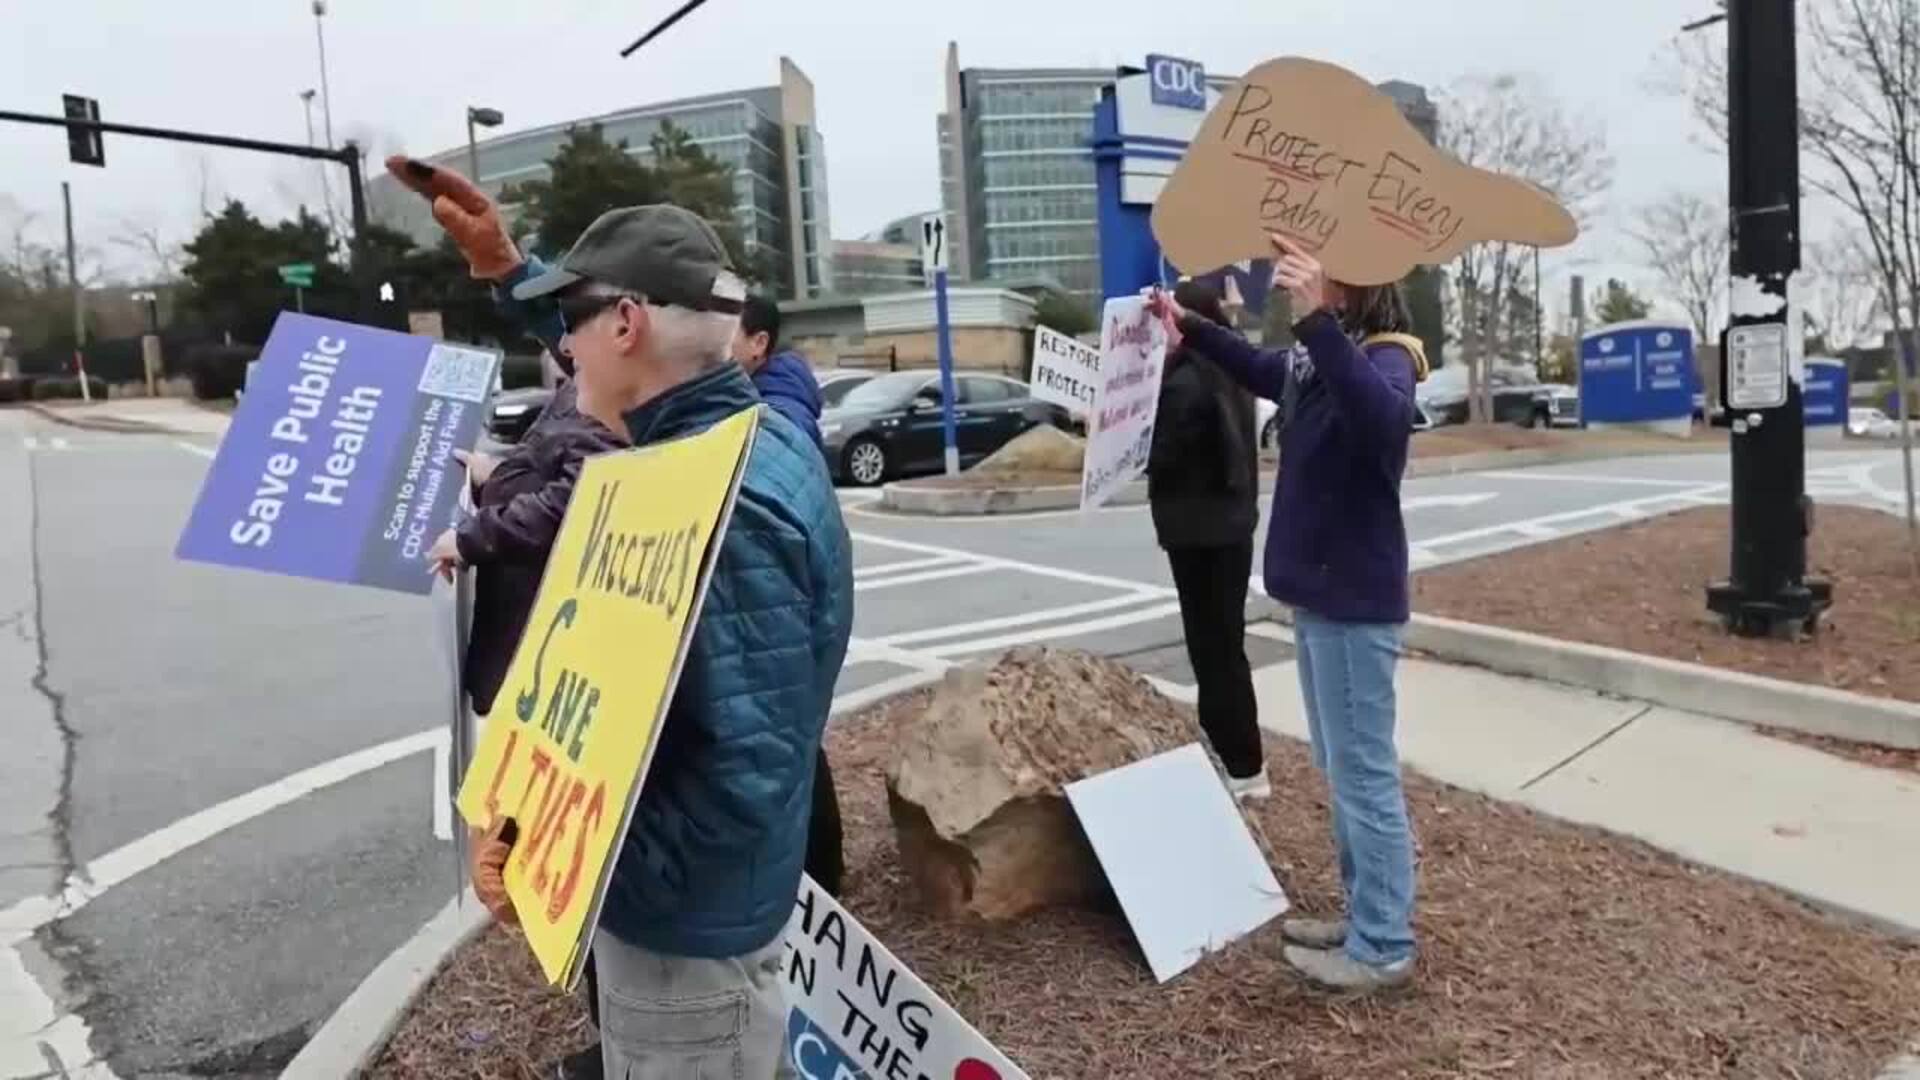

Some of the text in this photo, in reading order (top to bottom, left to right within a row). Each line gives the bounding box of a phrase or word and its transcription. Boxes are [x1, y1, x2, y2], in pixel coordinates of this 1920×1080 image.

[1154, 60, 1203, 95] CDC
[1260, 177, 1338, 249] Baby
[1036, 366, 1096, 405] PROTECT
[1040, 332, 1100, 373] RESTORE
[230, 452, 298, 547] Save
[271, 335, 346, 443] Public
[304, 386, 383, 506] Health
[384, 398, 443, 541] Scan to support the
[402, 402, 464, 558] CDC Mutual Aid Fund
